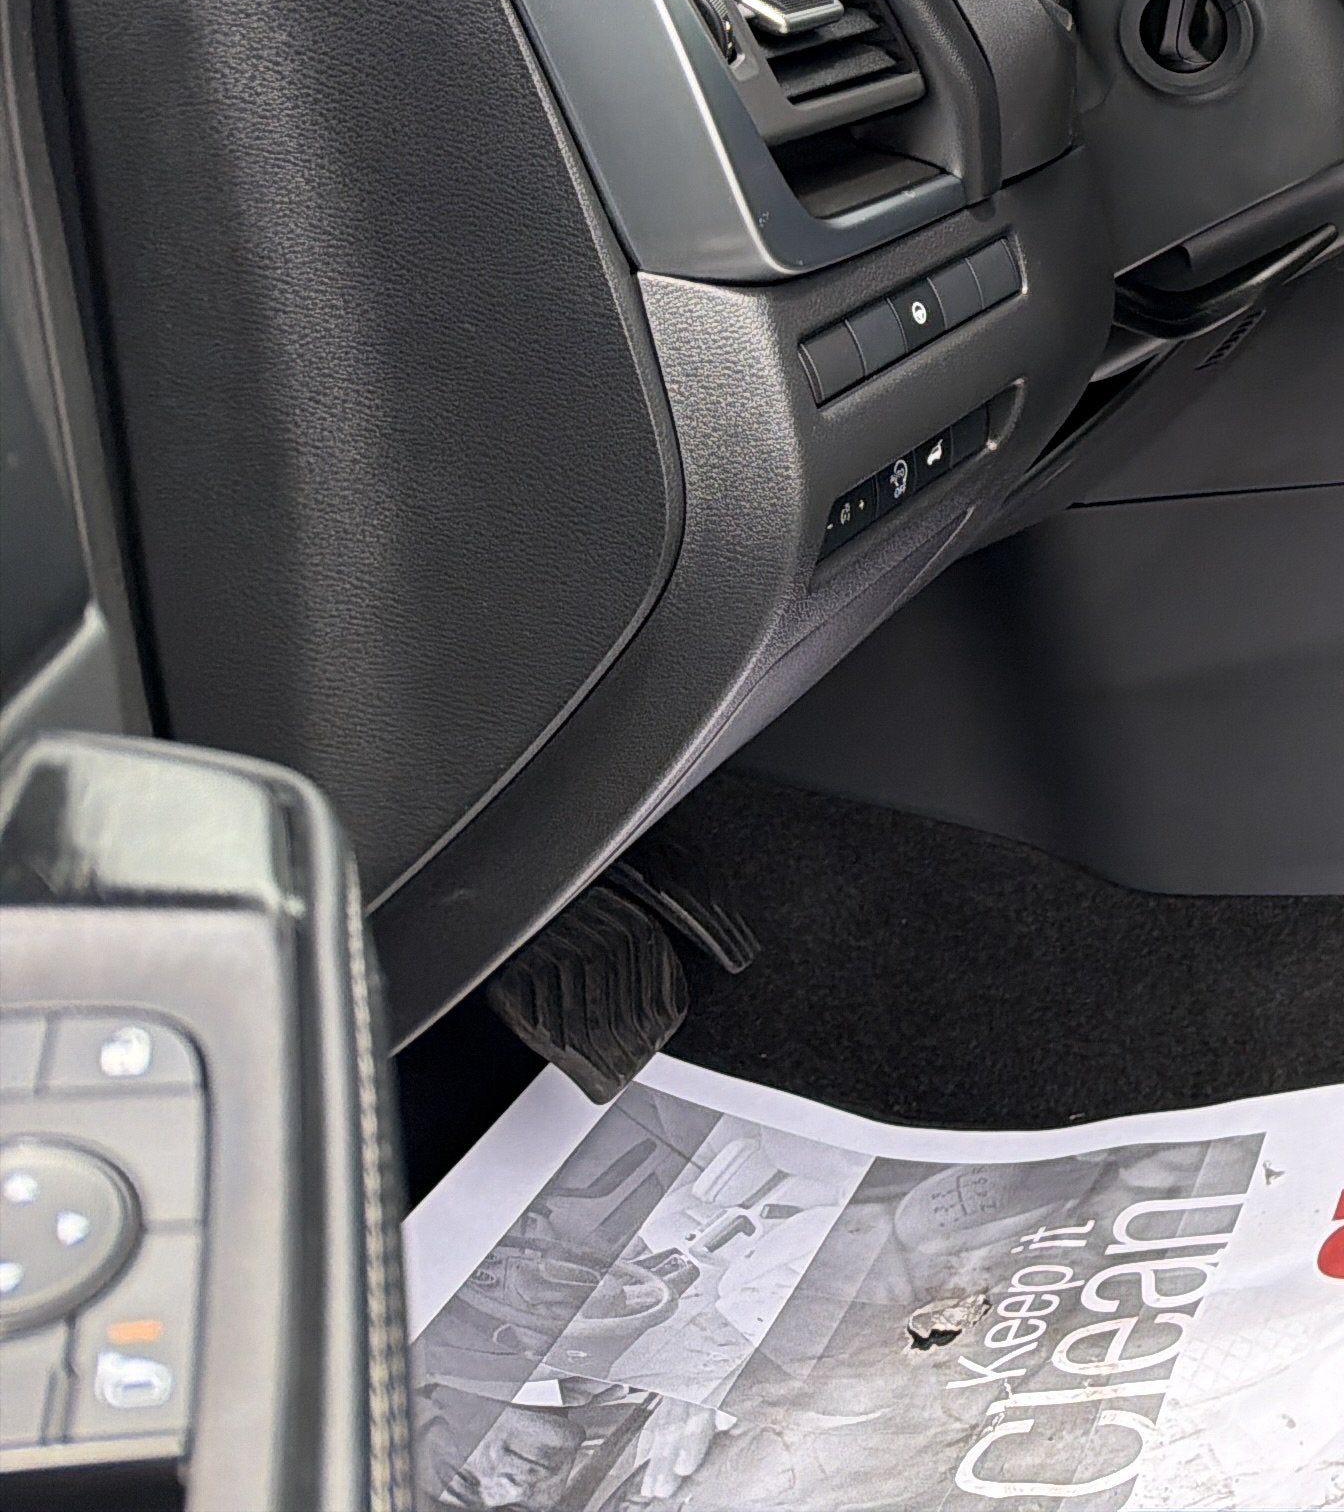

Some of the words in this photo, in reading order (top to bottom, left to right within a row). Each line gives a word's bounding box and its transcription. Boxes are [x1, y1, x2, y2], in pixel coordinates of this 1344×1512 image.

[1010, 1219, 1096, 1254] it
[945, 1264, 1085, 1389] Keep
[955, 1193, 1249, 1498] Clean
